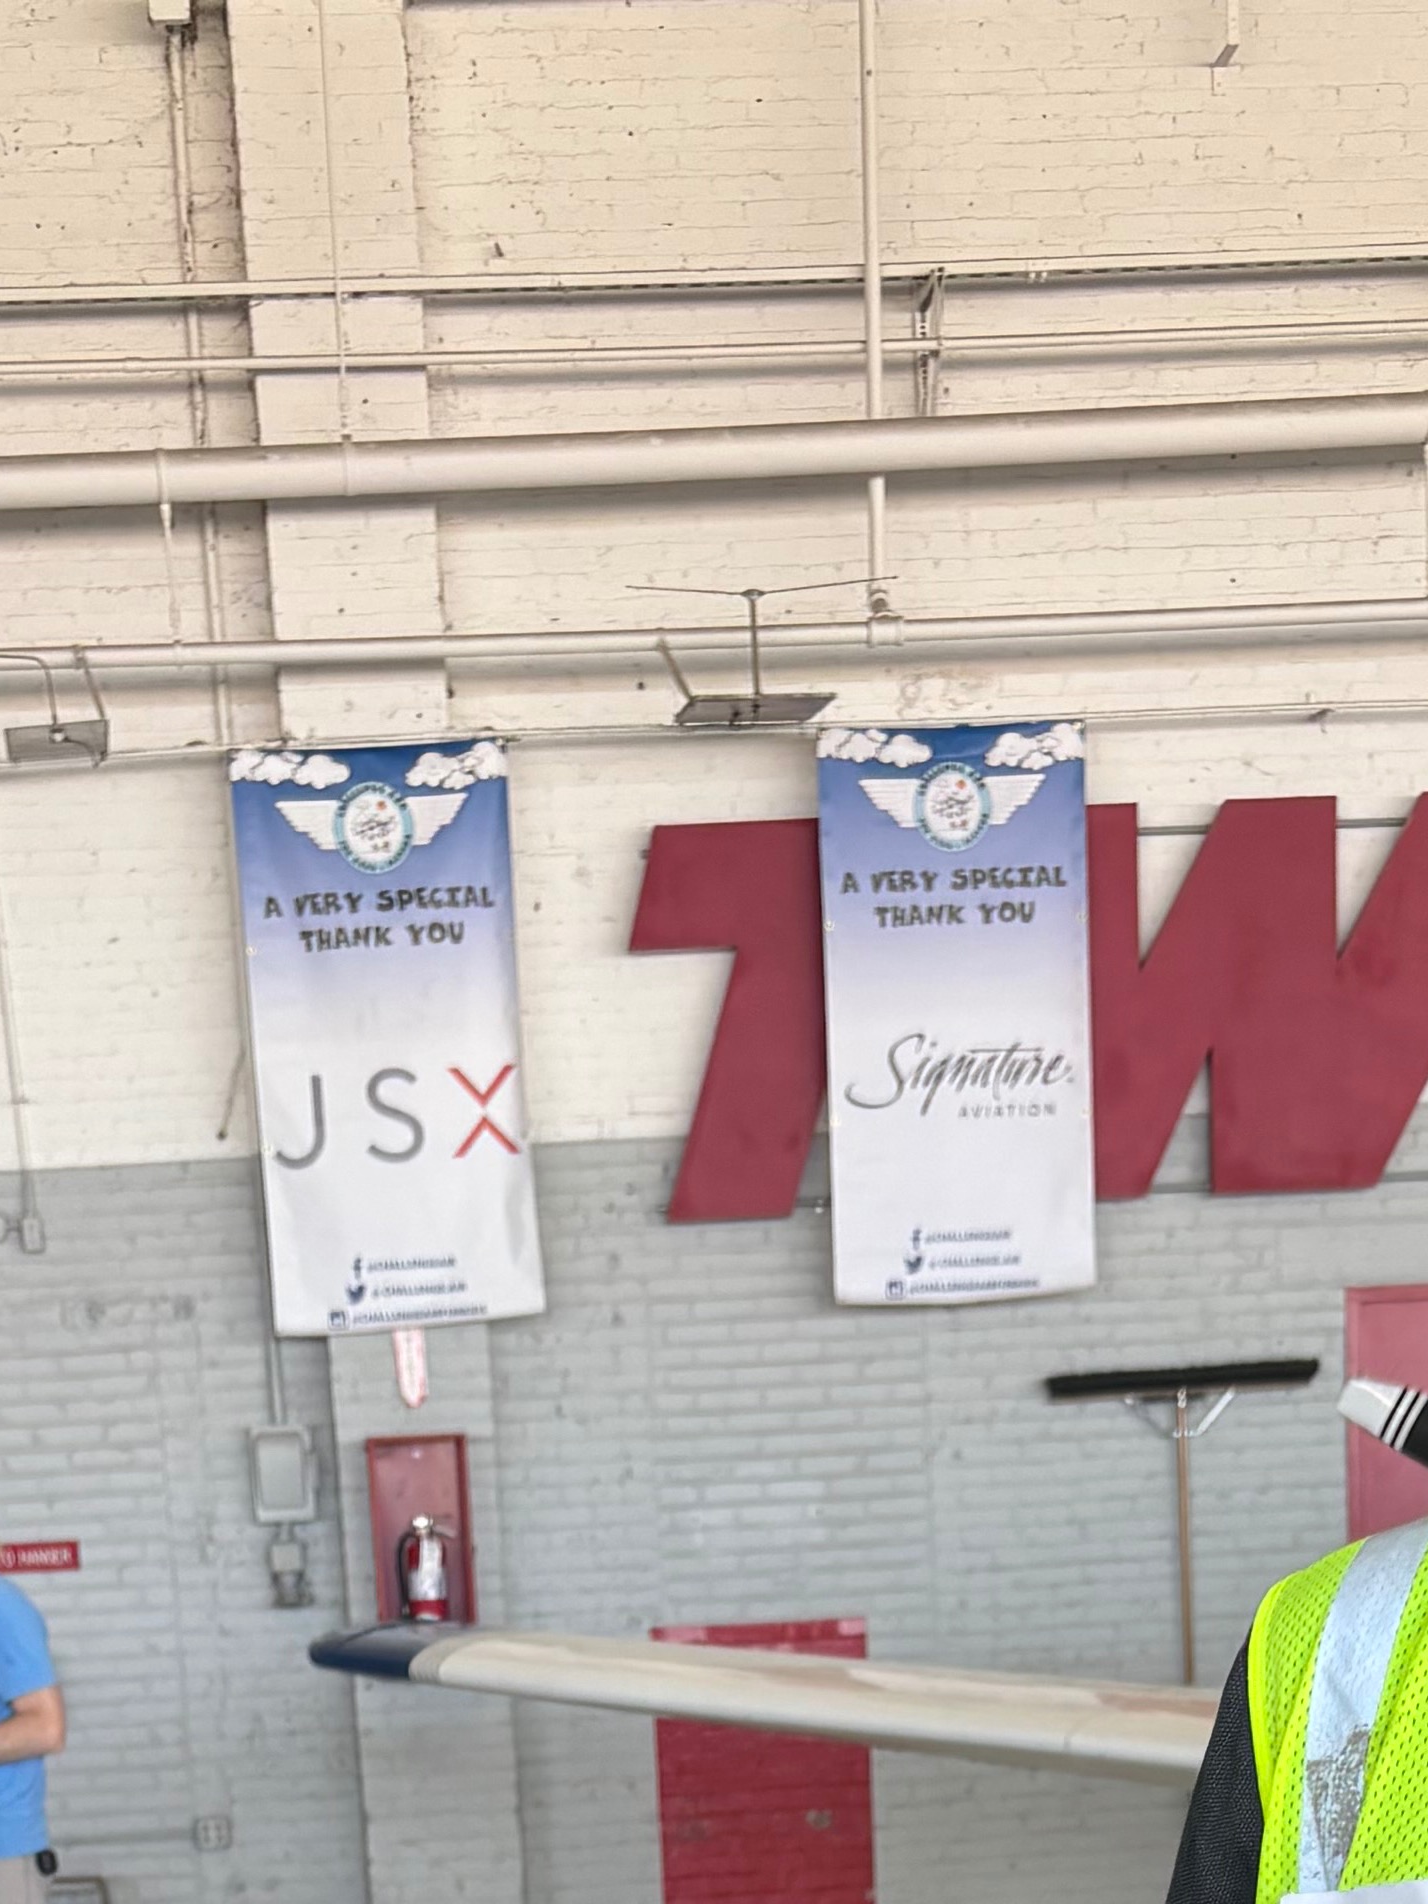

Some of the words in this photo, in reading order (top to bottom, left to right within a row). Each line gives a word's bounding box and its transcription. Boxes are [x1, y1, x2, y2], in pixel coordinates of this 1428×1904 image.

[840, 871, 860, 894] A
[870, 869, 937, 893] VERY
[949, 865, 1066, 891] SPECIAL
[264, 896, 283, 918] A
[293, 891, 362, 917] VERY
[377, 885, 495, 912] SPECIAL
[874, 903, 966, 928] THANK
[978, 900, 1036, 924] YOU
[299, 925, 392, 952] THANK
[405, 921, 465, 945] YOU
[274, 1064, 520, 1170] JSX
[958, 1103, 1058, 1119] AVIATION
